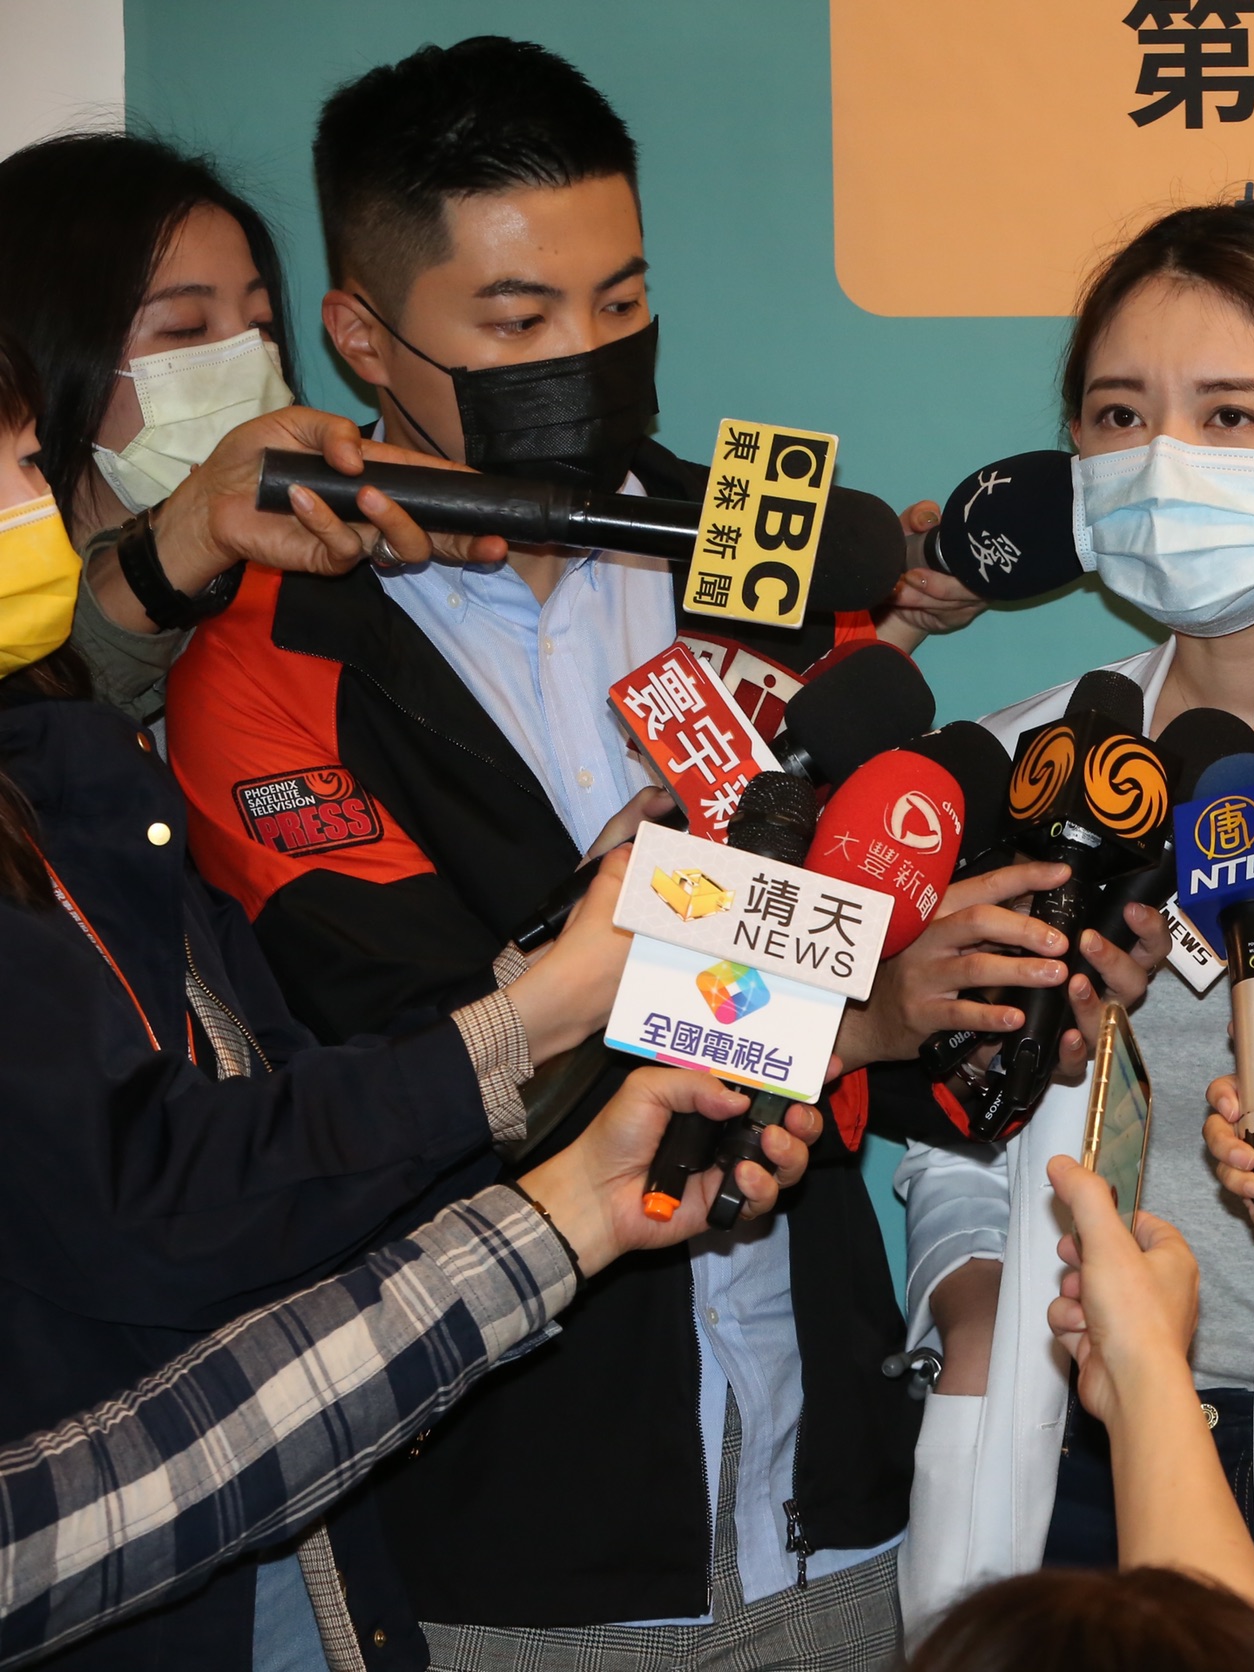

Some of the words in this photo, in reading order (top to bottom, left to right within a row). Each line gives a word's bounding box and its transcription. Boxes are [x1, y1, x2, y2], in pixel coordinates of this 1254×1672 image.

[693, 427, 760, 608] 東森新聞
[963, 471, 1022, 583] 大愛
[244, 780, 298, 800] PHOENIX
[248, 789, 300, 808] SATELLITE
[250, 796, 316, 817] TELEVISION
[254, 798, 372, 851] PRESS
[1206, 802, 1252, 860] 唐
[824, 831, 938, 921] 大豐新聞
[744, 873, 863, 946] 靖天
[1160, 902, 1212, 966] NEWS
[733, 921, 855, 978] NEWS
[639, 1012, 793, 1082] 全國電視台
[985, 1090, 1004, 1120] SON
